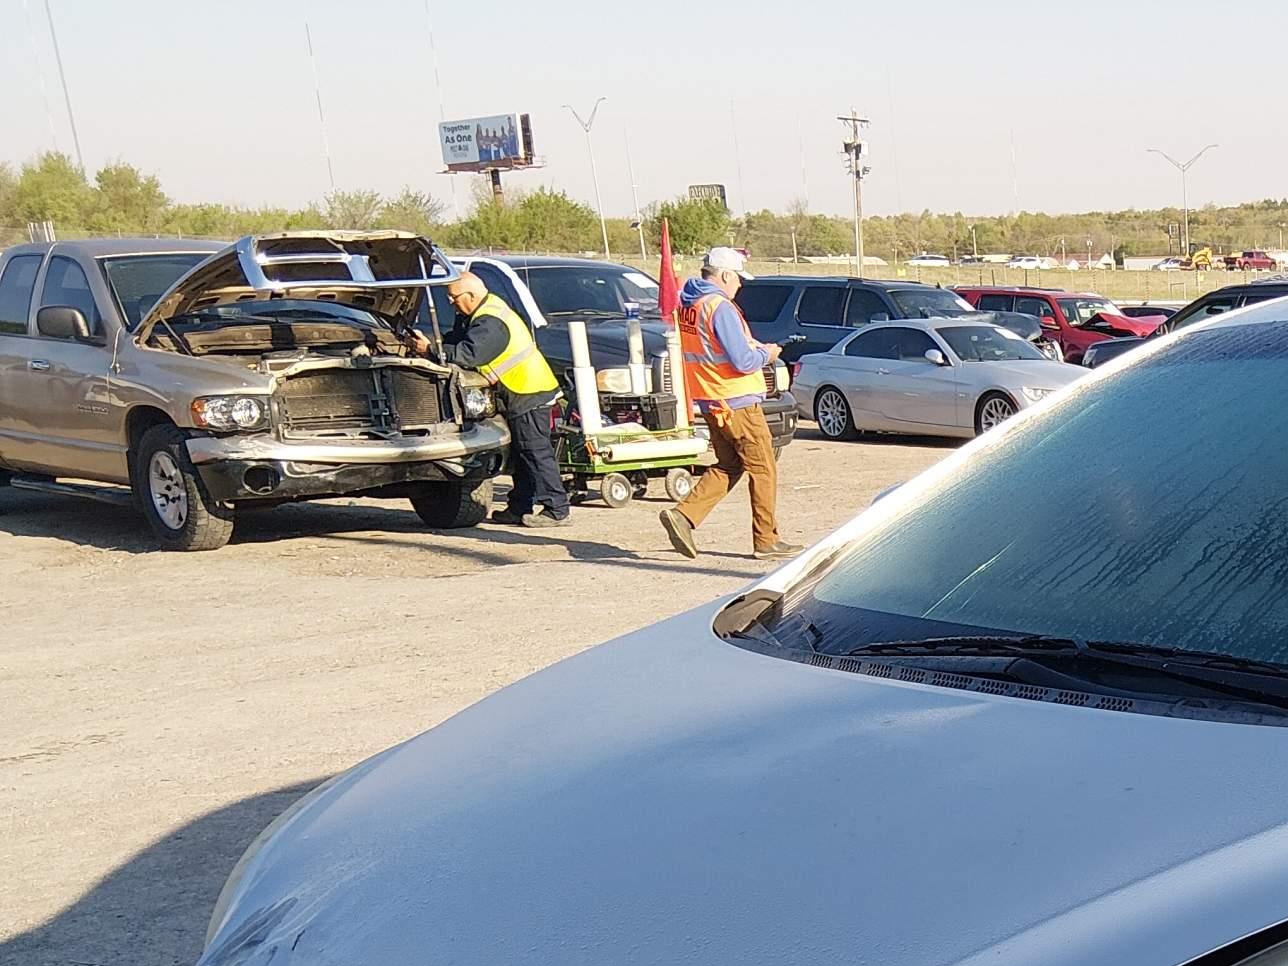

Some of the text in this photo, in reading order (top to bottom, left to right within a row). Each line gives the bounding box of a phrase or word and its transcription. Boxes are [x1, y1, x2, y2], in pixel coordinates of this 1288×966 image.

[443, 124, 470, 133] Together
[445, 134, 472, 144] As One
